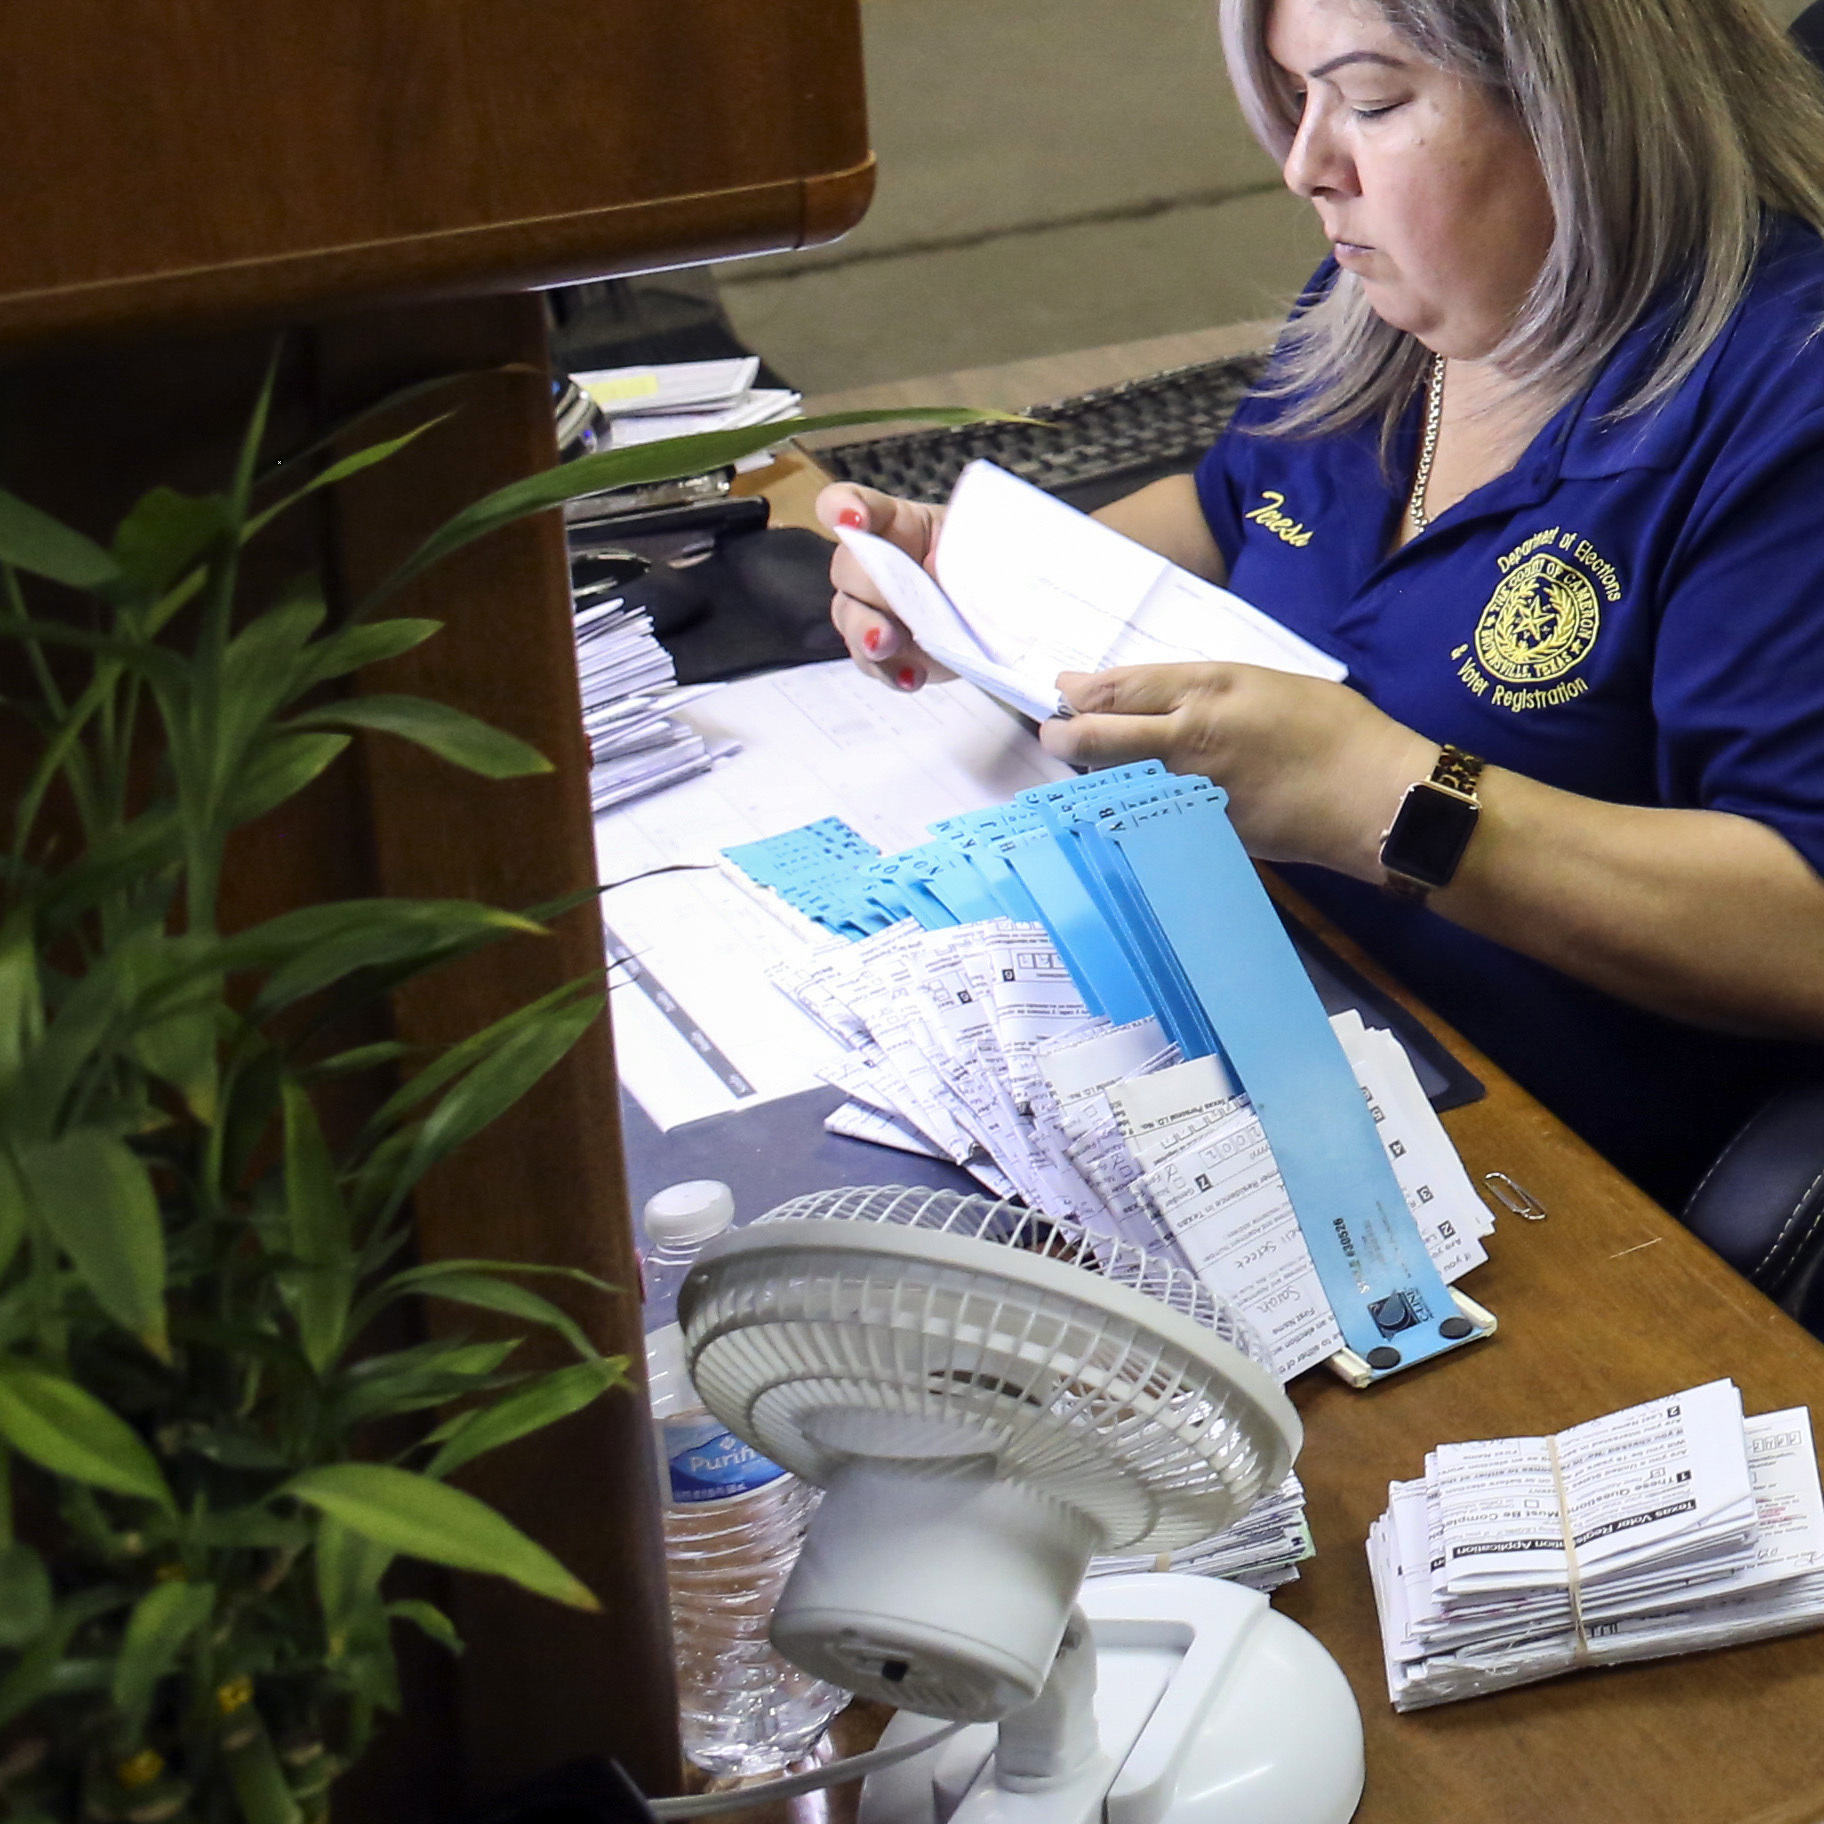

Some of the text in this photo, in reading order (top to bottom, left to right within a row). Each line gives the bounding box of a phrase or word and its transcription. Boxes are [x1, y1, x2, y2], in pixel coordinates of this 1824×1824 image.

[1559, 533, 1577, 551] of
[1574, 539, 1621, 602] Elections
[1563, 573, 1594, 640] CAMERON
[1534, 651, 1573, 678] TEXAS
[1457, 656, 1490, 697] Voter
[1491, 677, 1589, 713] Registration
[690, 1444, 758, 1473] Purifi
[1616, 1513, 1652, 1529] Voter
[1654, 1500, 1694, 1517] Texas
[1456, 1540, 1532, 1554] Application
